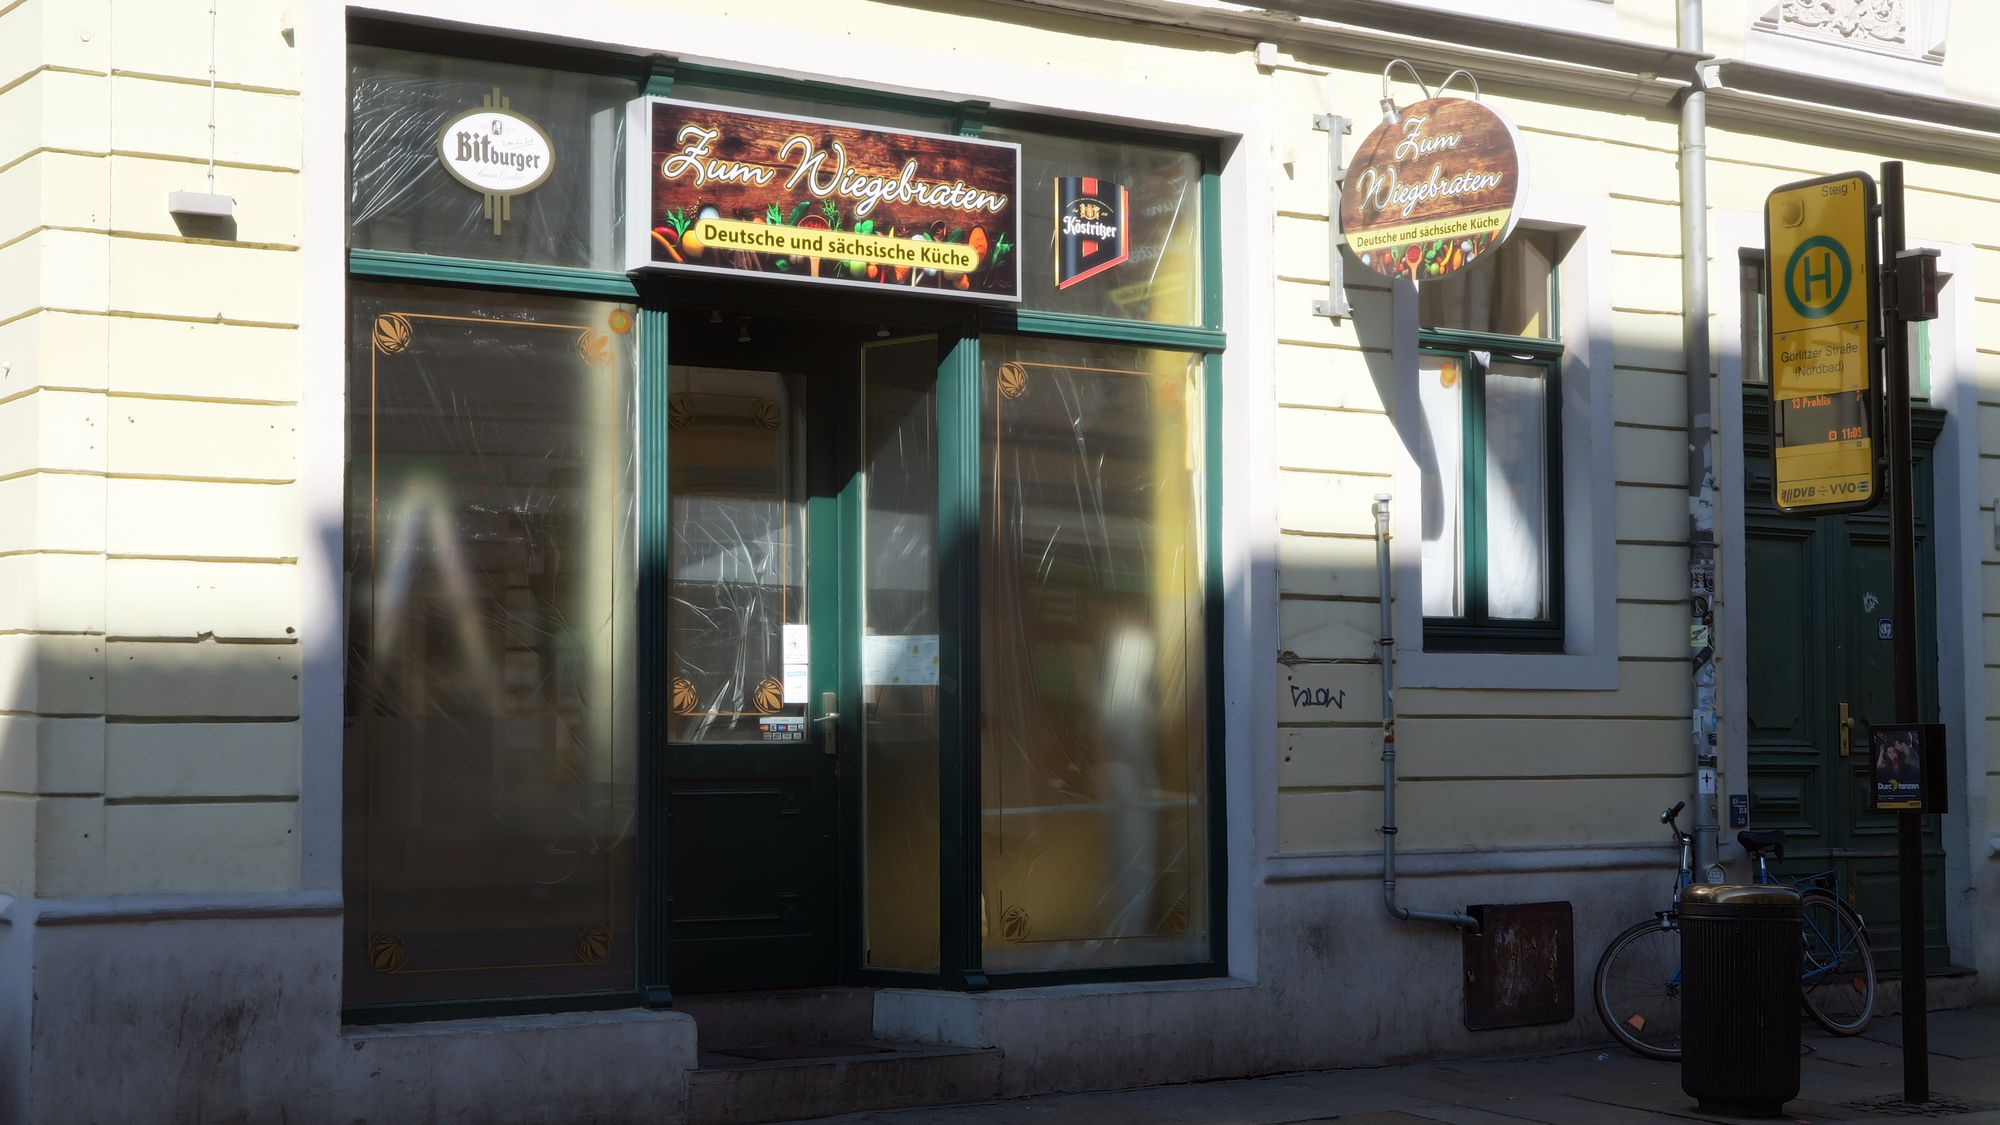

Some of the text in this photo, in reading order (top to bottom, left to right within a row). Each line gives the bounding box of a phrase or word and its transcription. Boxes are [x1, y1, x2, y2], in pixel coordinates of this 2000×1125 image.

[455, 131, 540, 171] Bitburger
[1395, 114, 1461, 161] Zum
[663, 125, 1006, 217] Zum Wiegebraten
[1356, 163, 1503, 218] Wiegebraten
[1822, 181, 1857, 197] Steig 1
[1063, 215, 1117, 240] Köstritzer
[1357, 216, 1500, 248] Deutsche und sächsische Küche
[704, 224, 970, 267] Deutsche und sächsische Küche
[1804, 252, 1832, 302] H
[1825, 343, 1858, 357] Straße
[1795, 360, 1845, 377] (Nordbad)
[1792, 397, 1801, 409] 13
[1802, 394, 1832, 408] Prohlis
[1842, 426, 1862, 440] 11:05
[1830, 482, 1856, 495] VVO
